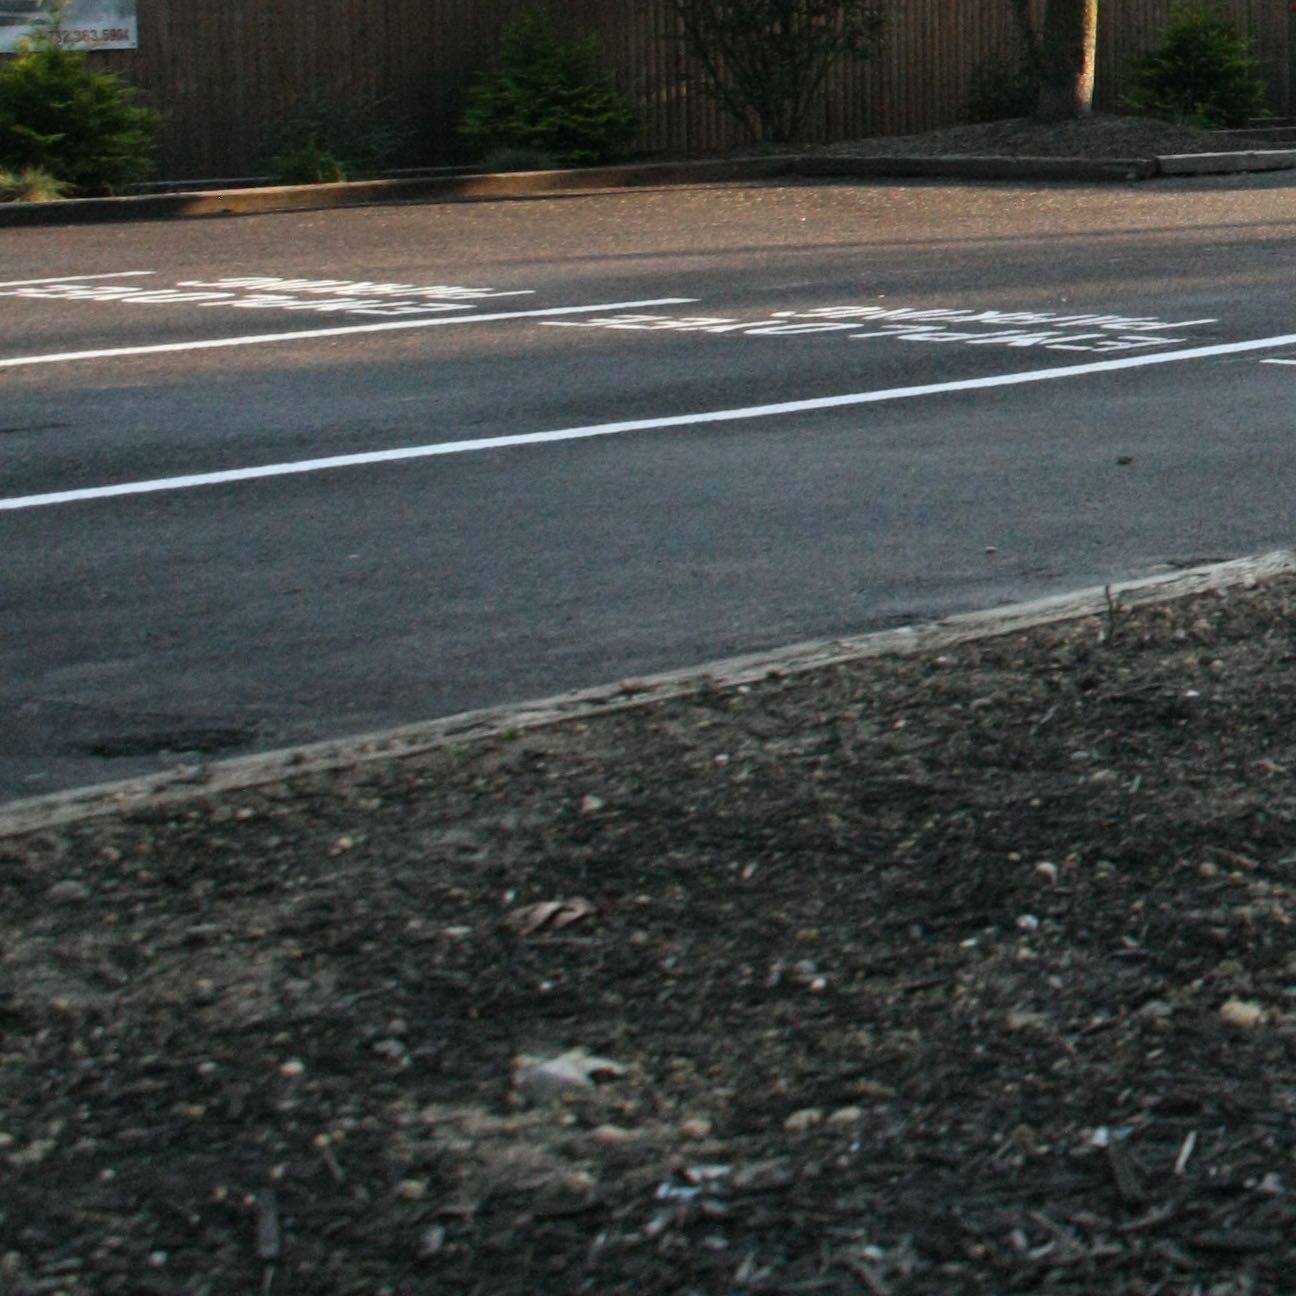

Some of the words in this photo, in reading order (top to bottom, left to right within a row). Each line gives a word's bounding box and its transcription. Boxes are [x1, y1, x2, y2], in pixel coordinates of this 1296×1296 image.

[178, 276, 536, 301] PARKING
[771, 306, 1219, 331] PARKING
[539, 315, 1187, 352] EMPLOYEE
